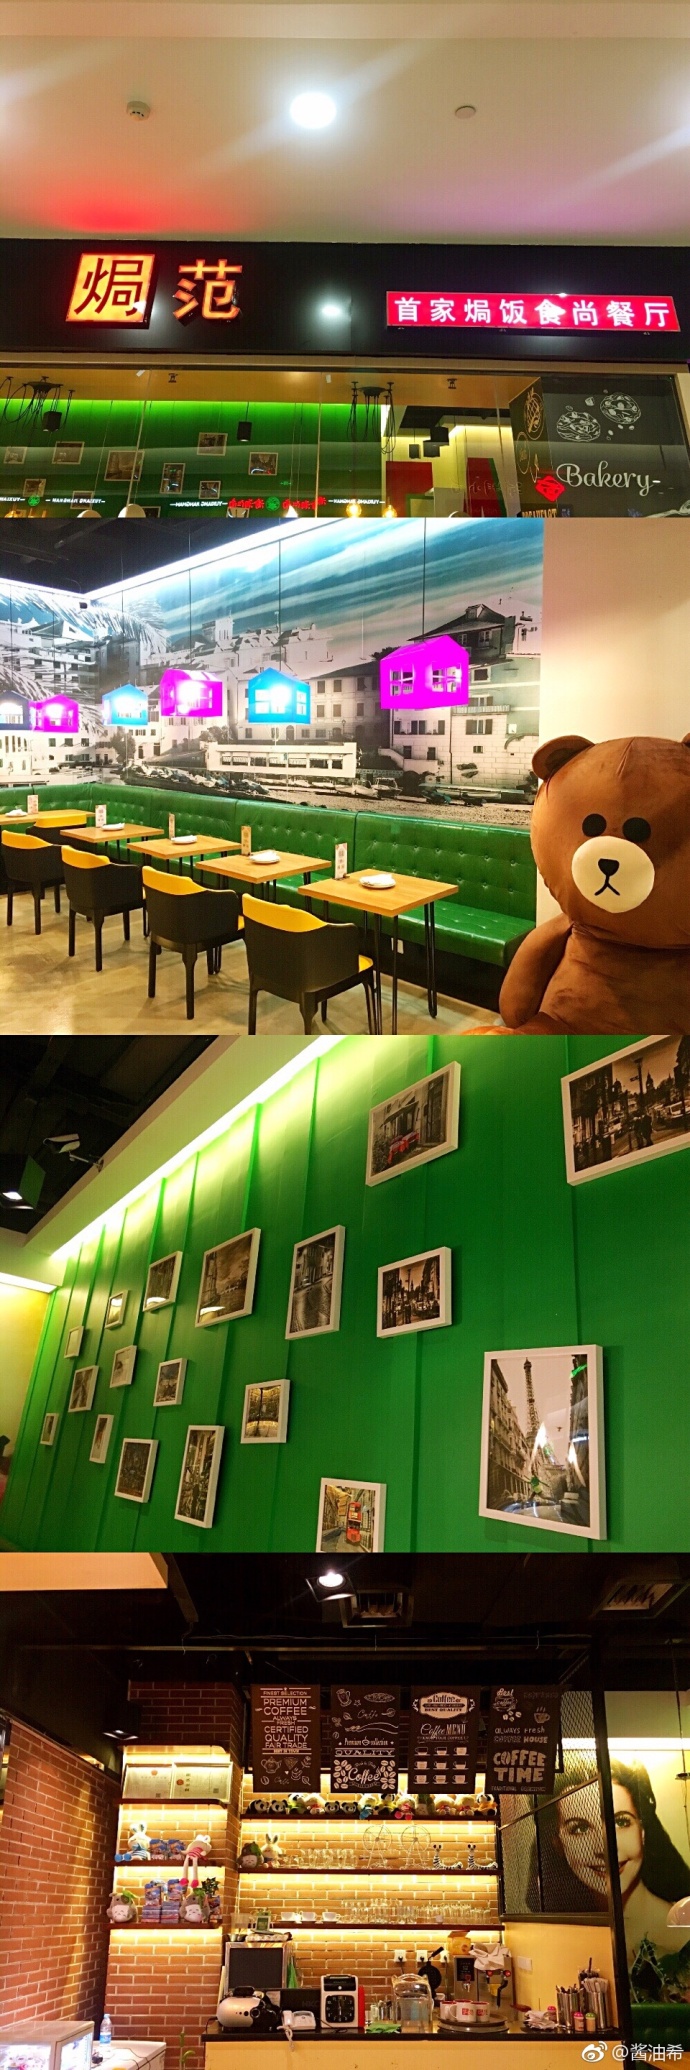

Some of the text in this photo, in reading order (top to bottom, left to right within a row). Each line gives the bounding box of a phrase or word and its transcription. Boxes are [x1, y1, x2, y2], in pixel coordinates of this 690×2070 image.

[70, 256, 243, 320] 焗范
[394, 297, 670, 327] 首家焗饭食尚餐厅
[556, 460, 653, 496] Bakery
[264, 1707, 307, 1715] COFFEE
[265, 1734, 308, 1742] QUALITY
[420, 1723, 466, 1738] Coffee MENU
[493, 1749, 546, 1766] COFFEE
[348, 1767, 380, 1784] Coffee
[494, 1767, 544, 1783] TIME
